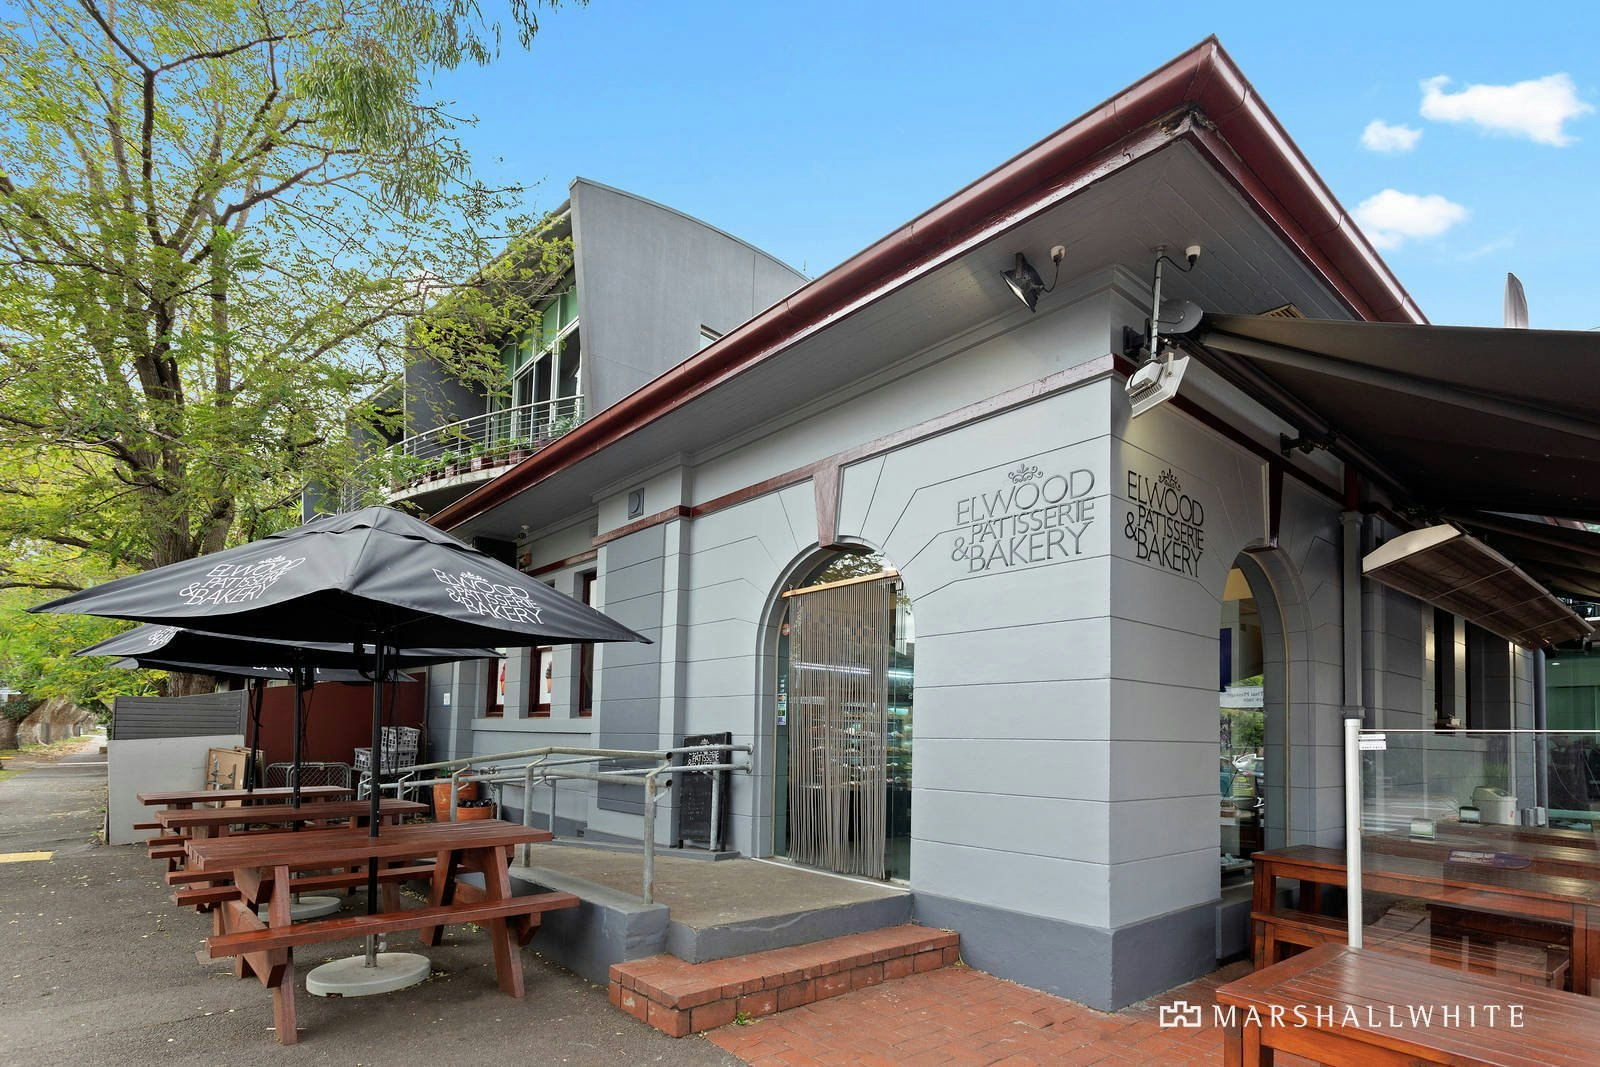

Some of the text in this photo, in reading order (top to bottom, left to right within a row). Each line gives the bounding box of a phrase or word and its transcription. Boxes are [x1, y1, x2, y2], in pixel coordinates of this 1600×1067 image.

[956, 468, 1095, 526] ELWOOD
[969, 496, 1095, 545] PATISSERIE
[1127, 469, 1204, 526] ELWOOD
[951, 520, 1094, 573] & BAKERY
[1124, 511, 1203, 578] & BAKERY
[1138, 504, 1204, 551] PATISSERIE
[206, 557, 306, 577] ELWOOD
[431, 567, 530, 599] ELWOOD
[454, 584, 541, 609] PATISSERIE
[460, 596, 544, 624] BAKERY
